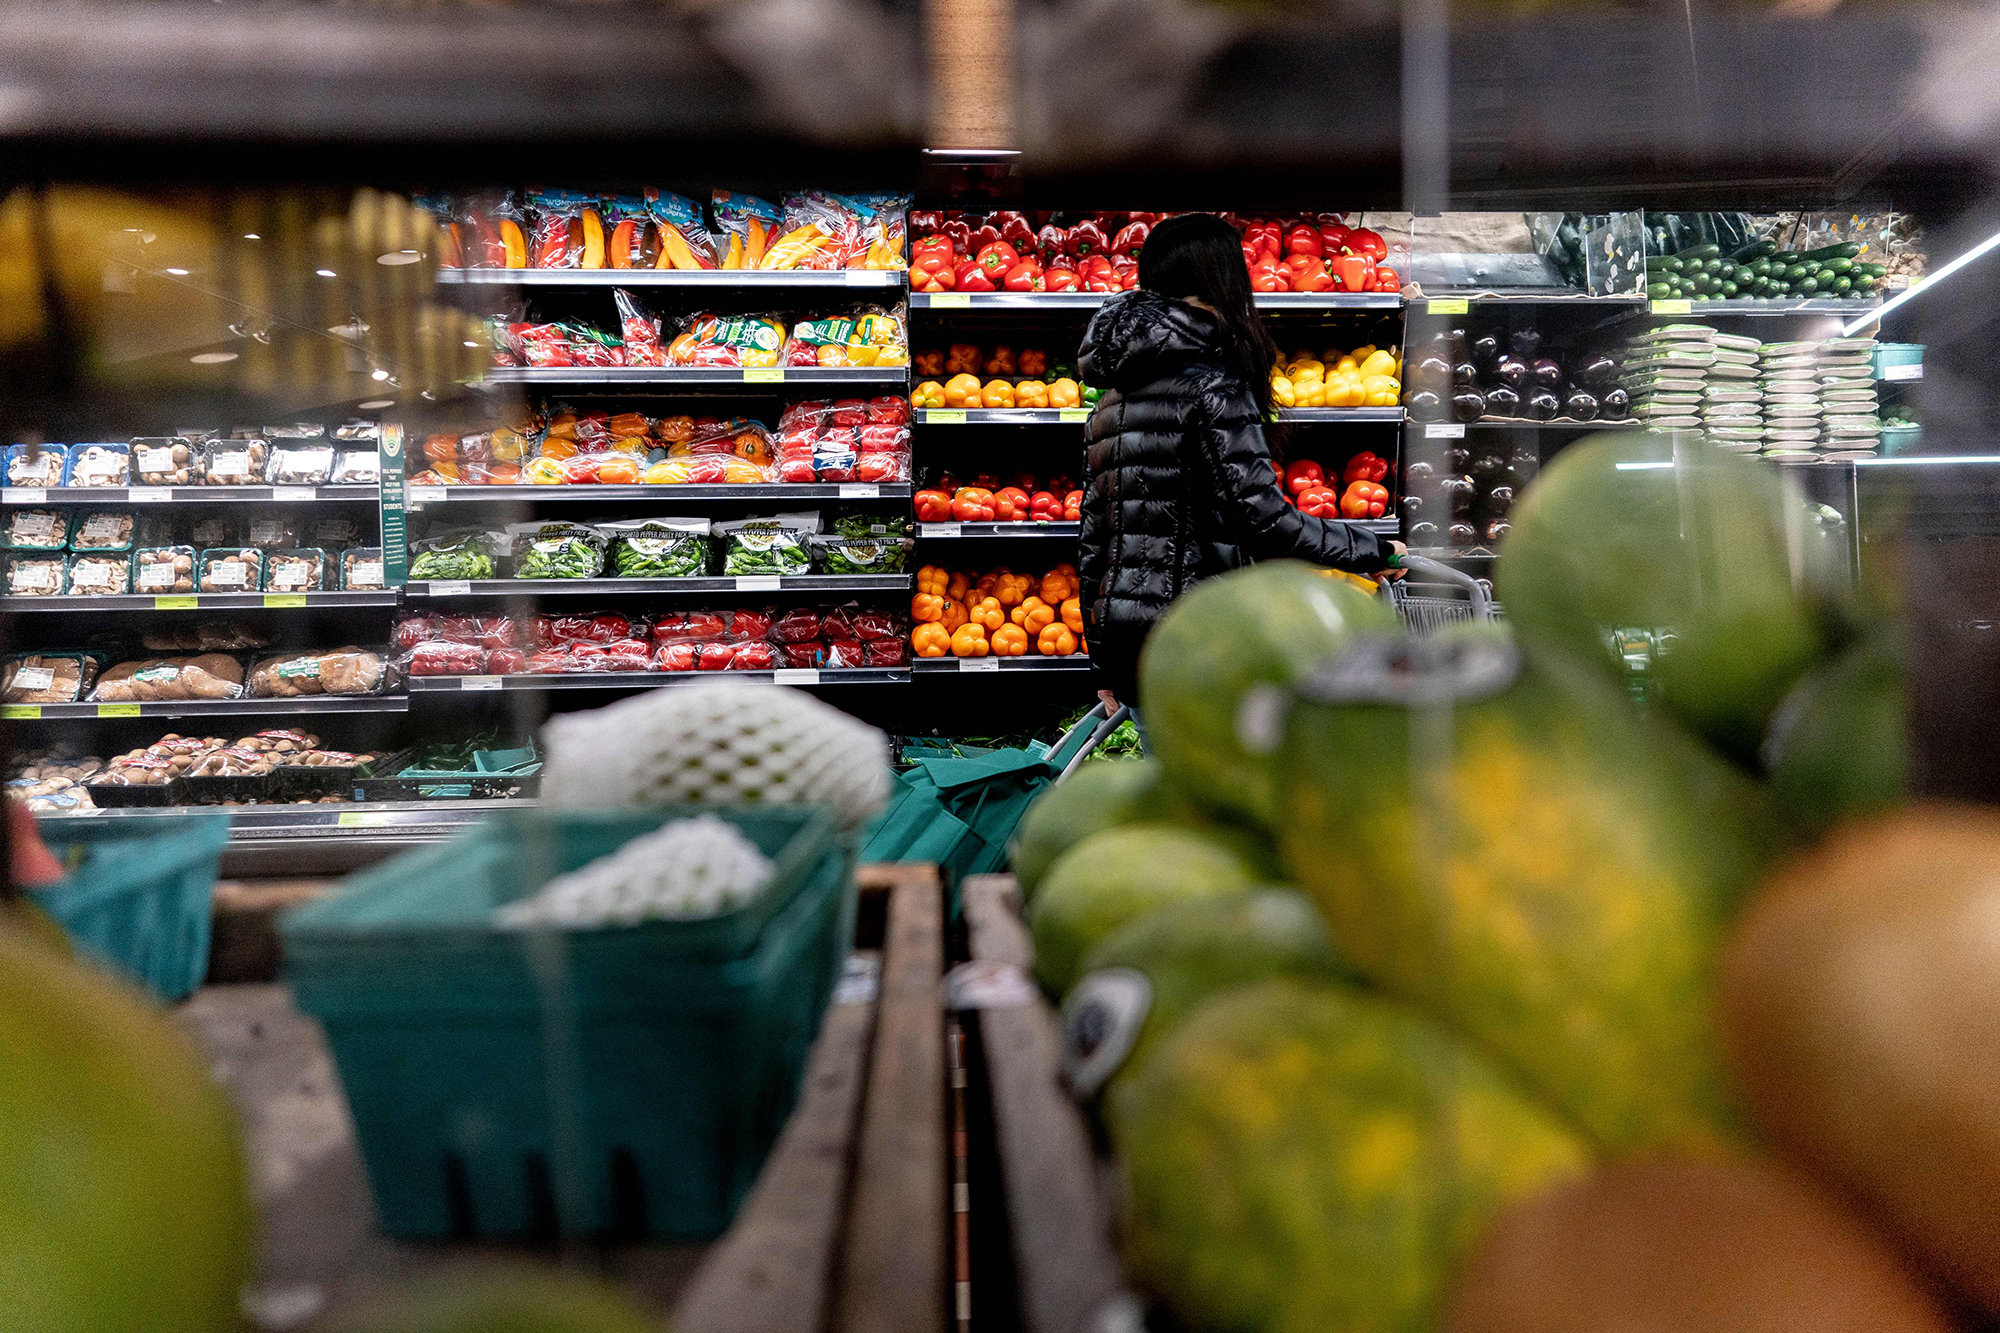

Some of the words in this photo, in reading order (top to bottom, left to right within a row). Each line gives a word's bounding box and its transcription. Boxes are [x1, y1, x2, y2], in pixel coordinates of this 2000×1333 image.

[668, 202, 682, 212] WILD
[640, 531, 658, 539] PEPPER
[659, 531, 675, 539] PARTY
[675, 531, 687, 539] PACK
